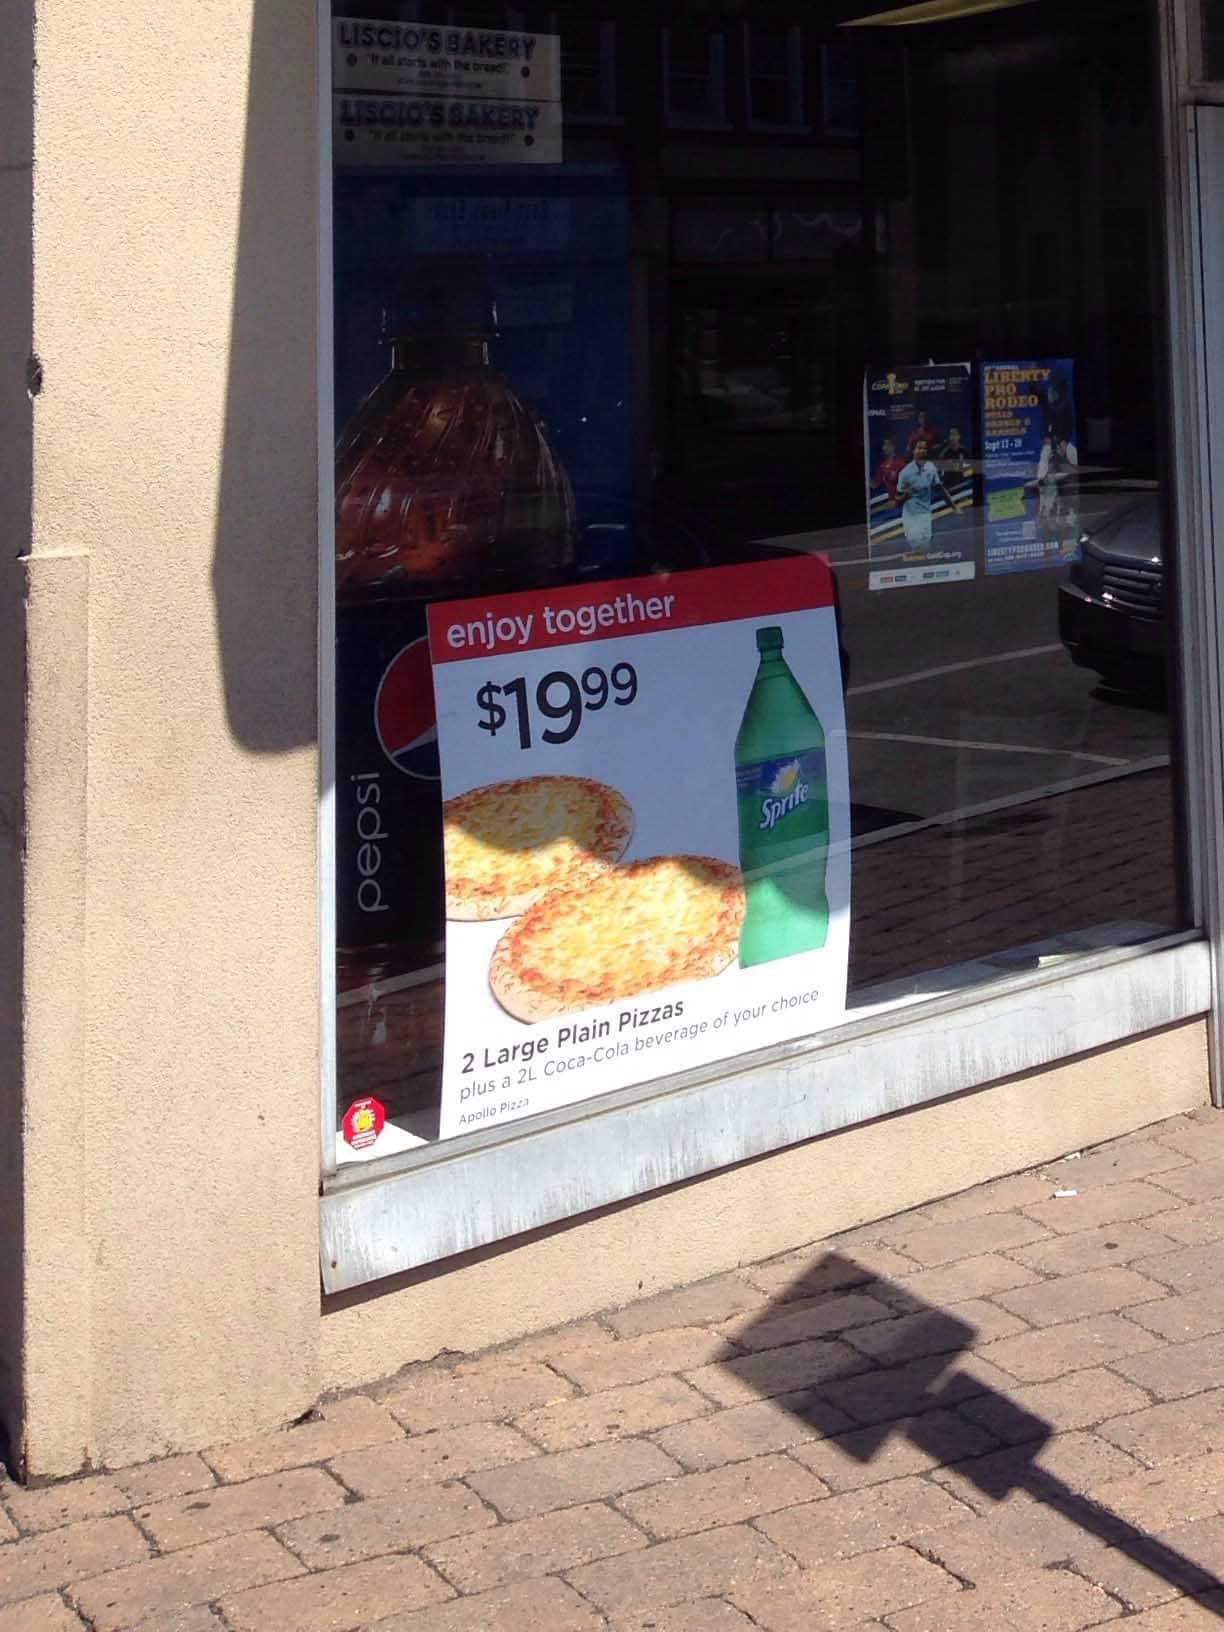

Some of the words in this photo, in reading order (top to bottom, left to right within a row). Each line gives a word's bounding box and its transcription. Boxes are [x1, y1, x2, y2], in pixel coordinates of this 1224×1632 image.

[339, 23, 441, 53] LISCIO'S
[446, 30, 536, 60] BAKERY
[449, 102, 540, 130] BAKERY
[446, 612, 534, 650] enjoy
[543, 593, 675, 636] together
[759, 779, 809, 829] Sprite
[350, 772, 390, 913] pepsi
[459, 1079, 496, 1103] plus
[501, 1075, 511, 1089] a
[517, 1067, 537, 1085] 2L
[544, 1042, 629, 1077] Coca-Cola
[634, 1020, 708, 1052] beverage
[712, 1014, 730, 1030] of
[733, 1004, 766, 1027] your
[771, 989, 819, 1013] choice
[460, 1052, 475, 1074] 2
[484, 1037, 549, 1069] Large
[557, 1019, 611, 1048] Plain
[618, 1000, 684, 1032] Pizzas
[458, 1105, 497, 1126] Apollo
[500, 1098, 529, 1113] Pizza
